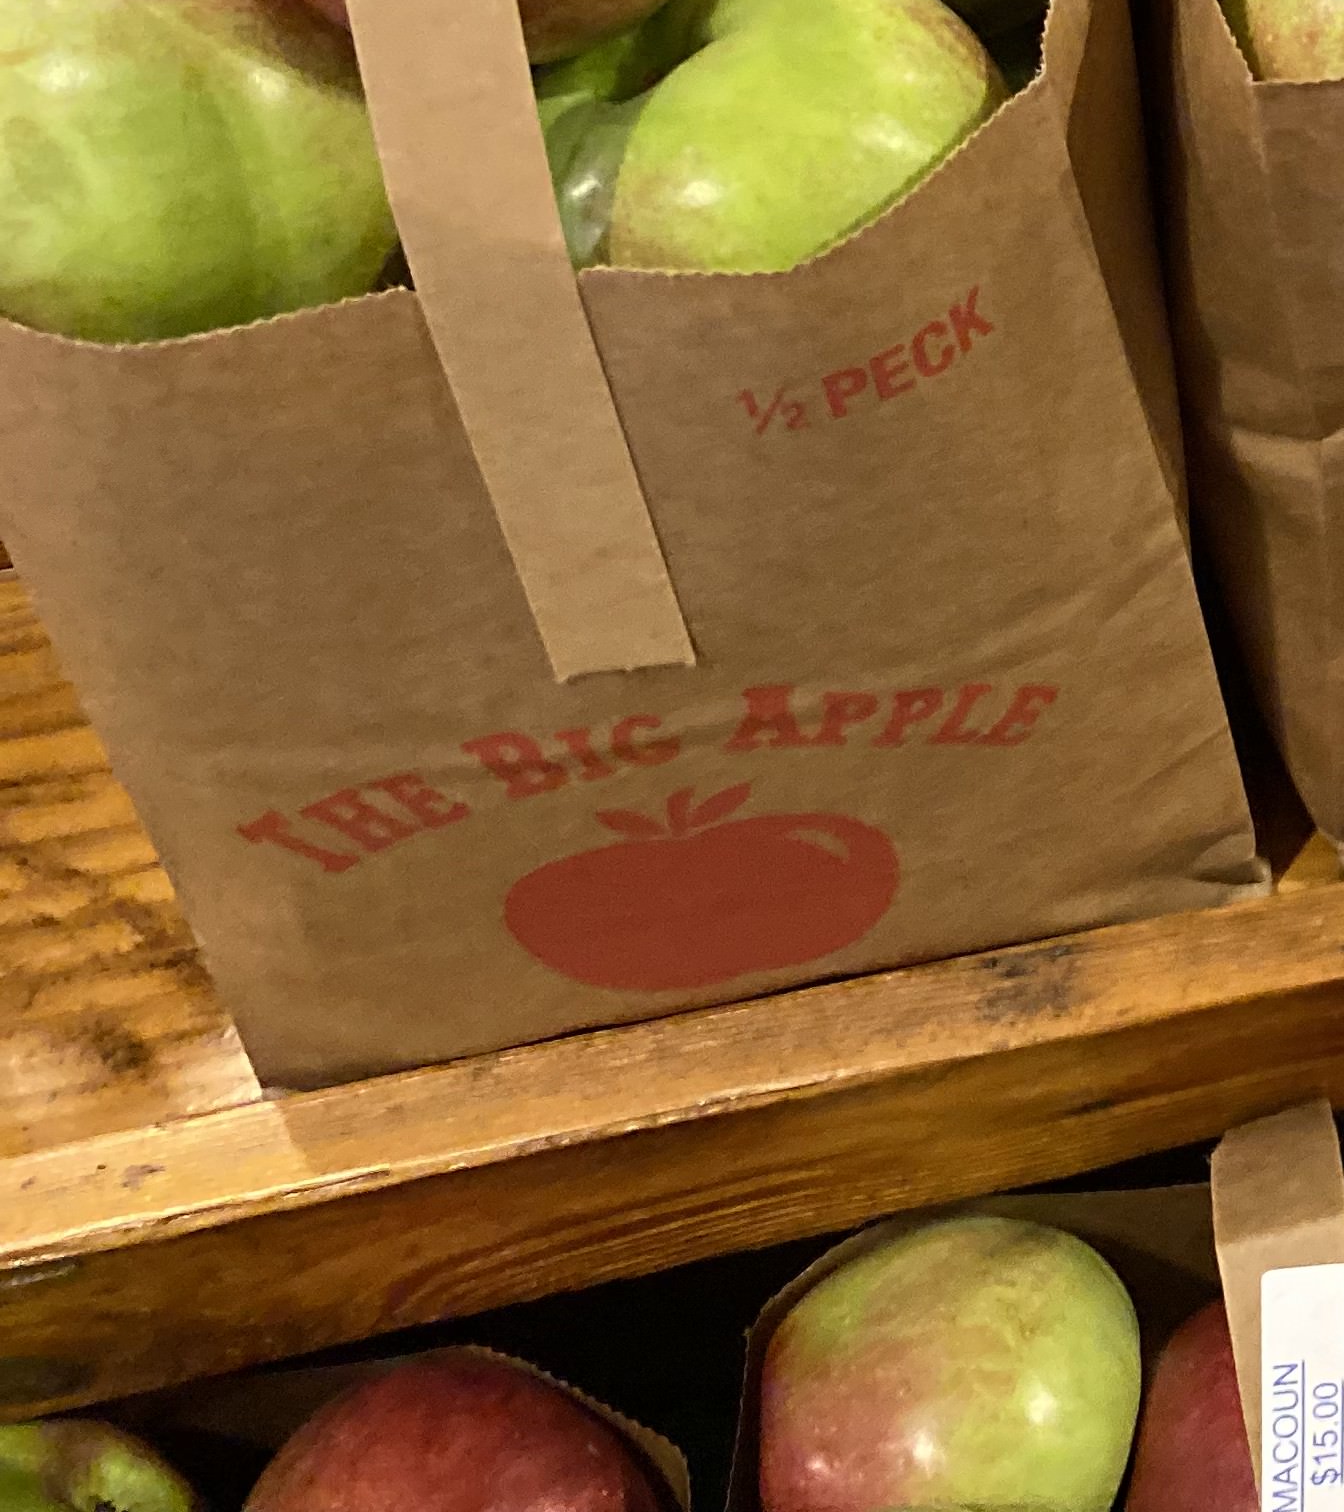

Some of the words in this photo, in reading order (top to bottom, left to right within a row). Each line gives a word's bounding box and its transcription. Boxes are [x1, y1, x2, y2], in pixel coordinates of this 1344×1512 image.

[821, 284, 994, 419] PECK
[235, 772, 471, 874] THE
[459, 713, 683, 802] BIG
[723, 682, 1059, 752] APPLE
[1272, 1362, 1306, 1512] MACOUN
